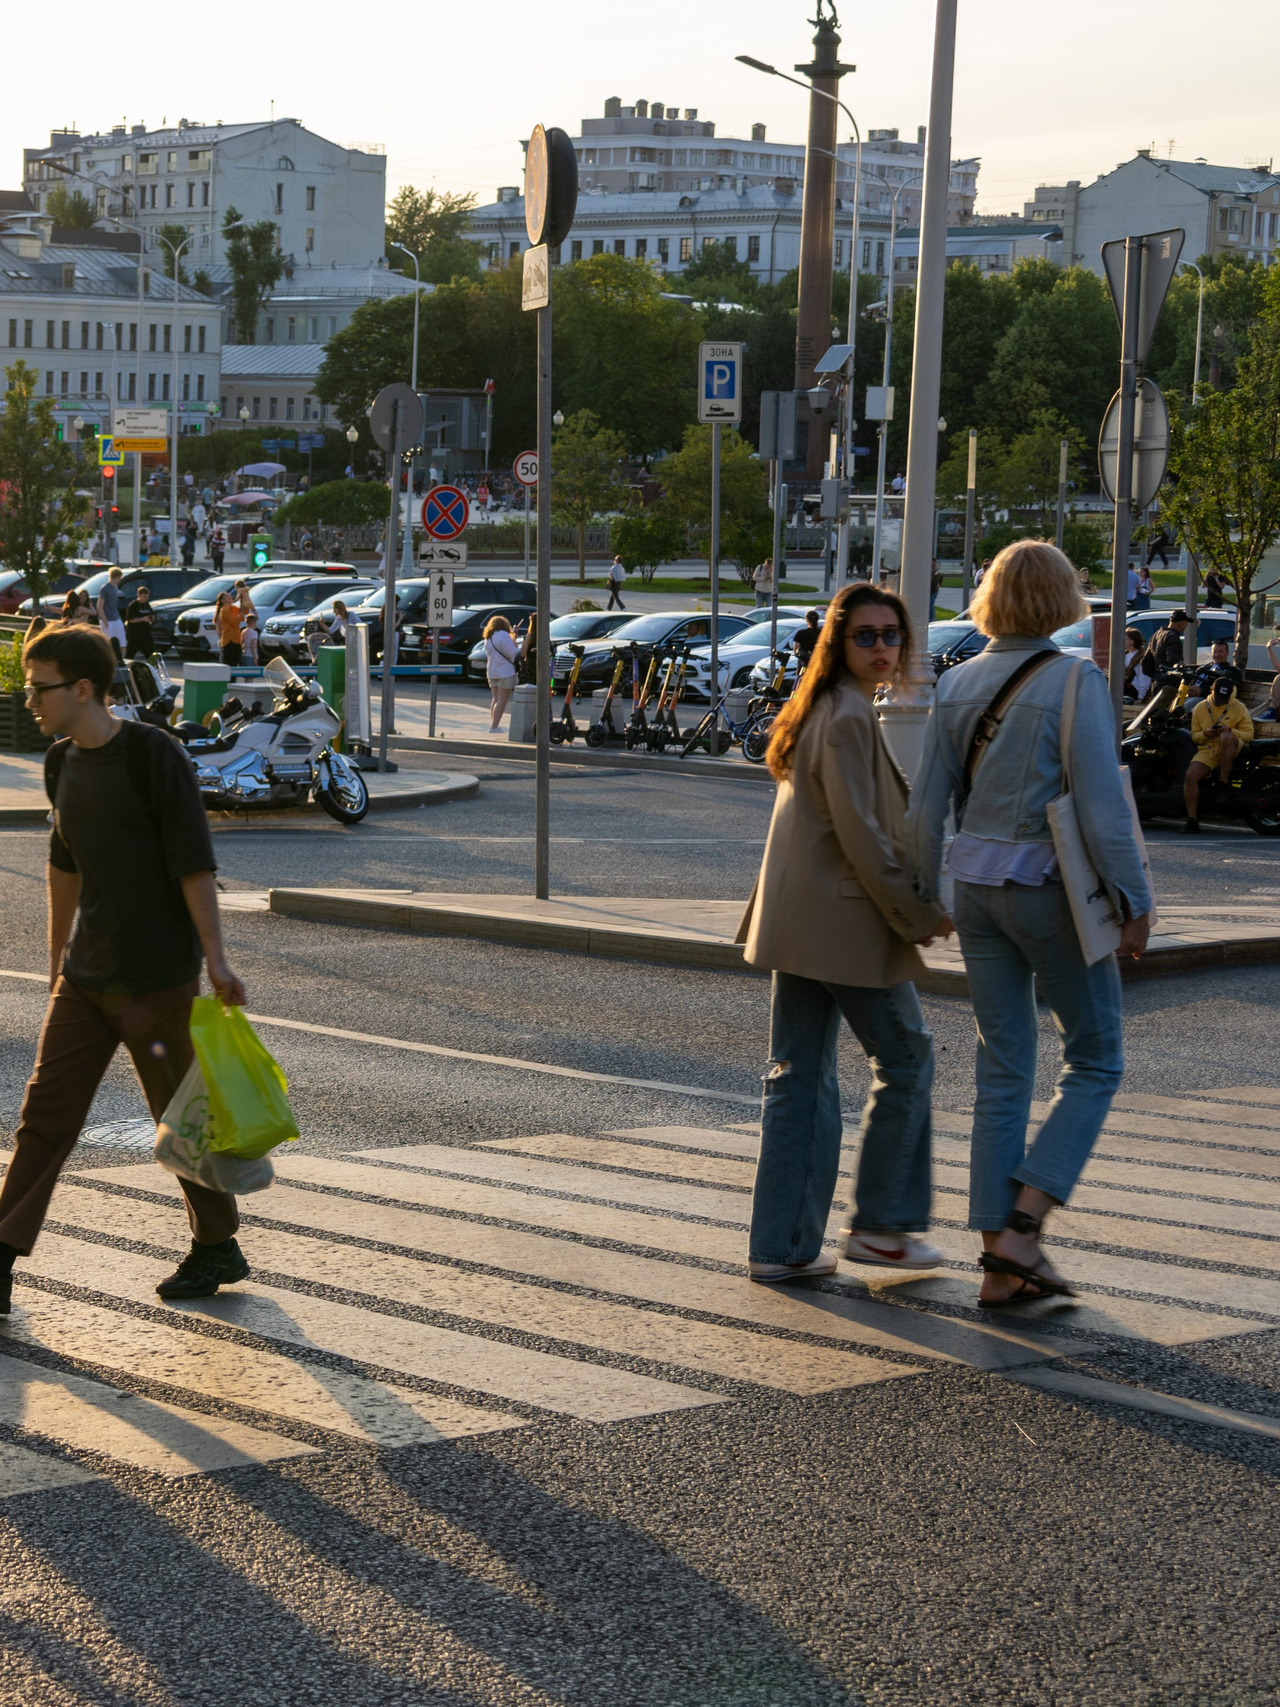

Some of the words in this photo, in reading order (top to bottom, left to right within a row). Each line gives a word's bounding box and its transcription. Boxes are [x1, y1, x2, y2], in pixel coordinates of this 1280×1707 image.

[710, 347, 733, 357] ЗОНА
[713, 364, 731, 396] P
[521, 462, 538, 476] 50
[434, 598, 447, 609] 60
